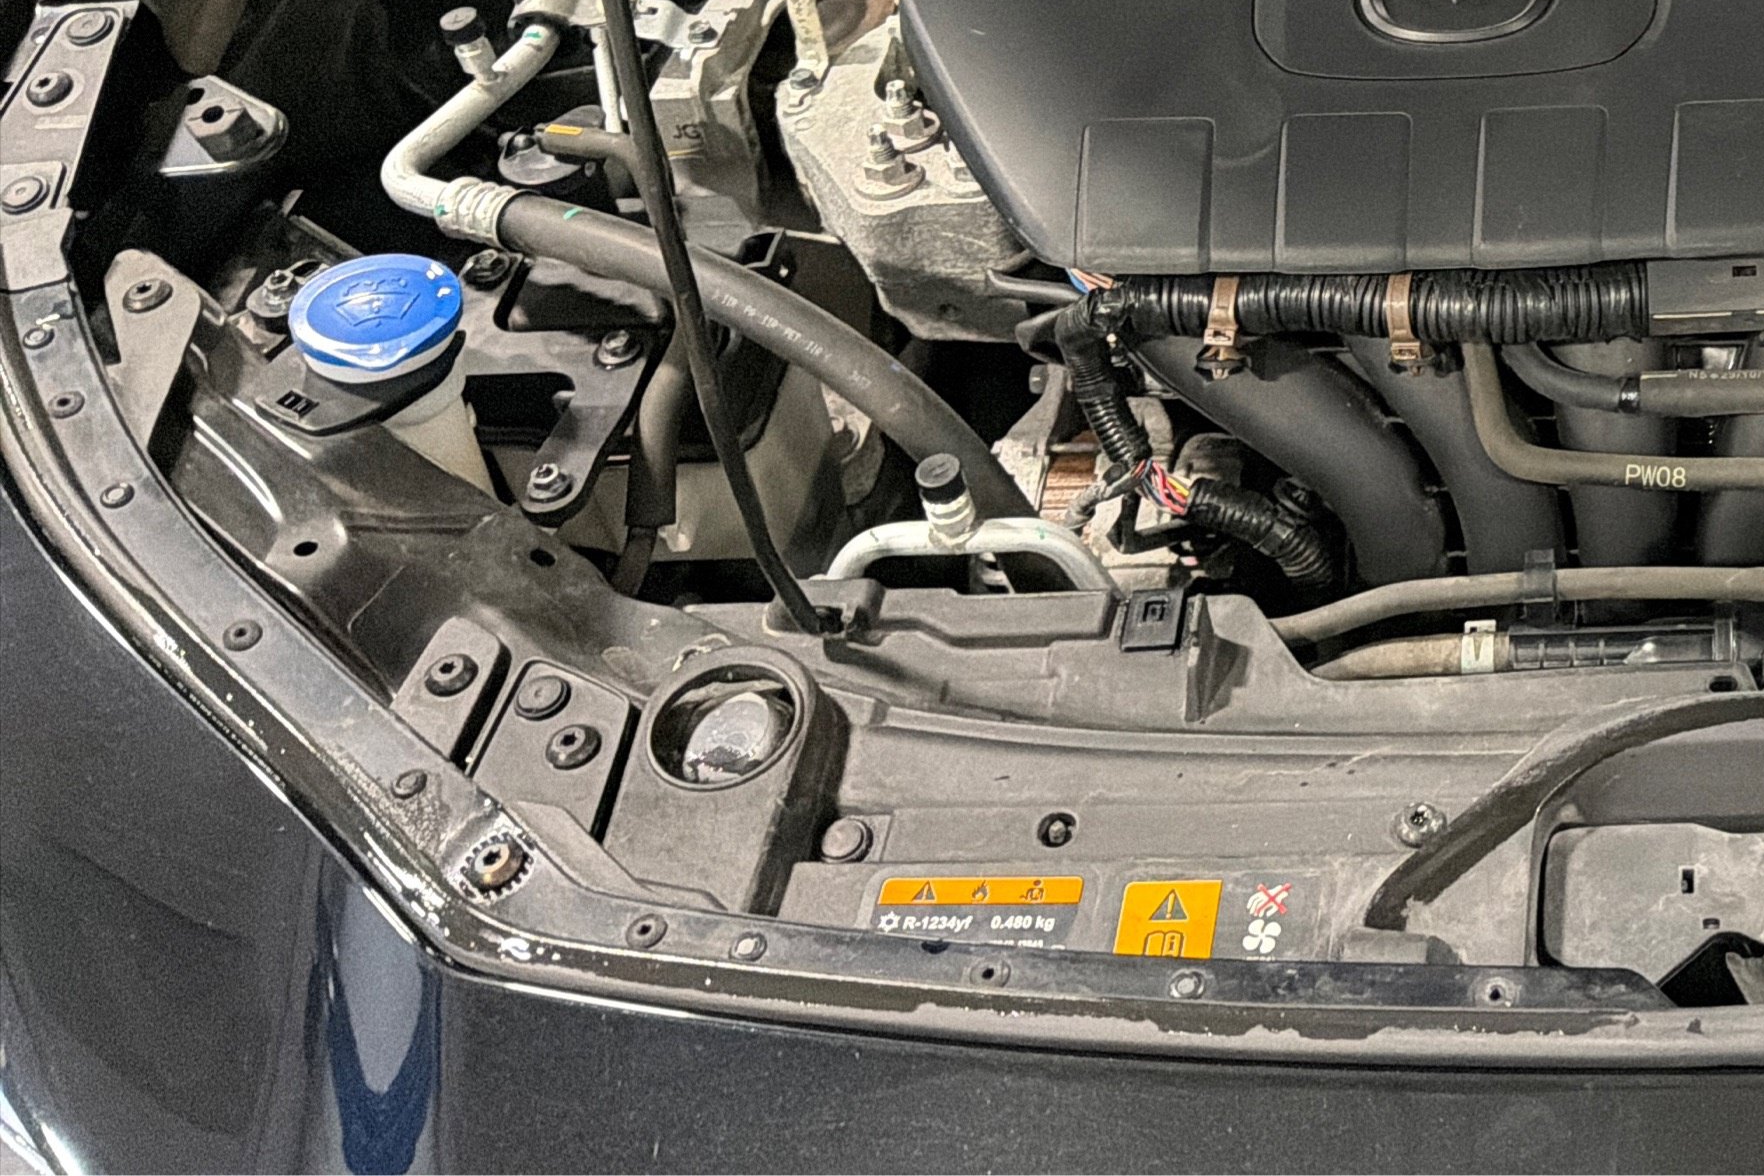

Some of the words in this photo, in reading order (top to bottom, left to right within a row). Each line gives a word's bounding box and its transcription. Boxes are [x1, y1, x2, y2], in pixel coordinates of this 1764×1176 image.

[1625, 464, 1686, 488] PW08
[902, 915, 973, 933] R-1234yf
[990, 915, 1031, 930] 0.480
[1034, 915, 1056, 932] kg
